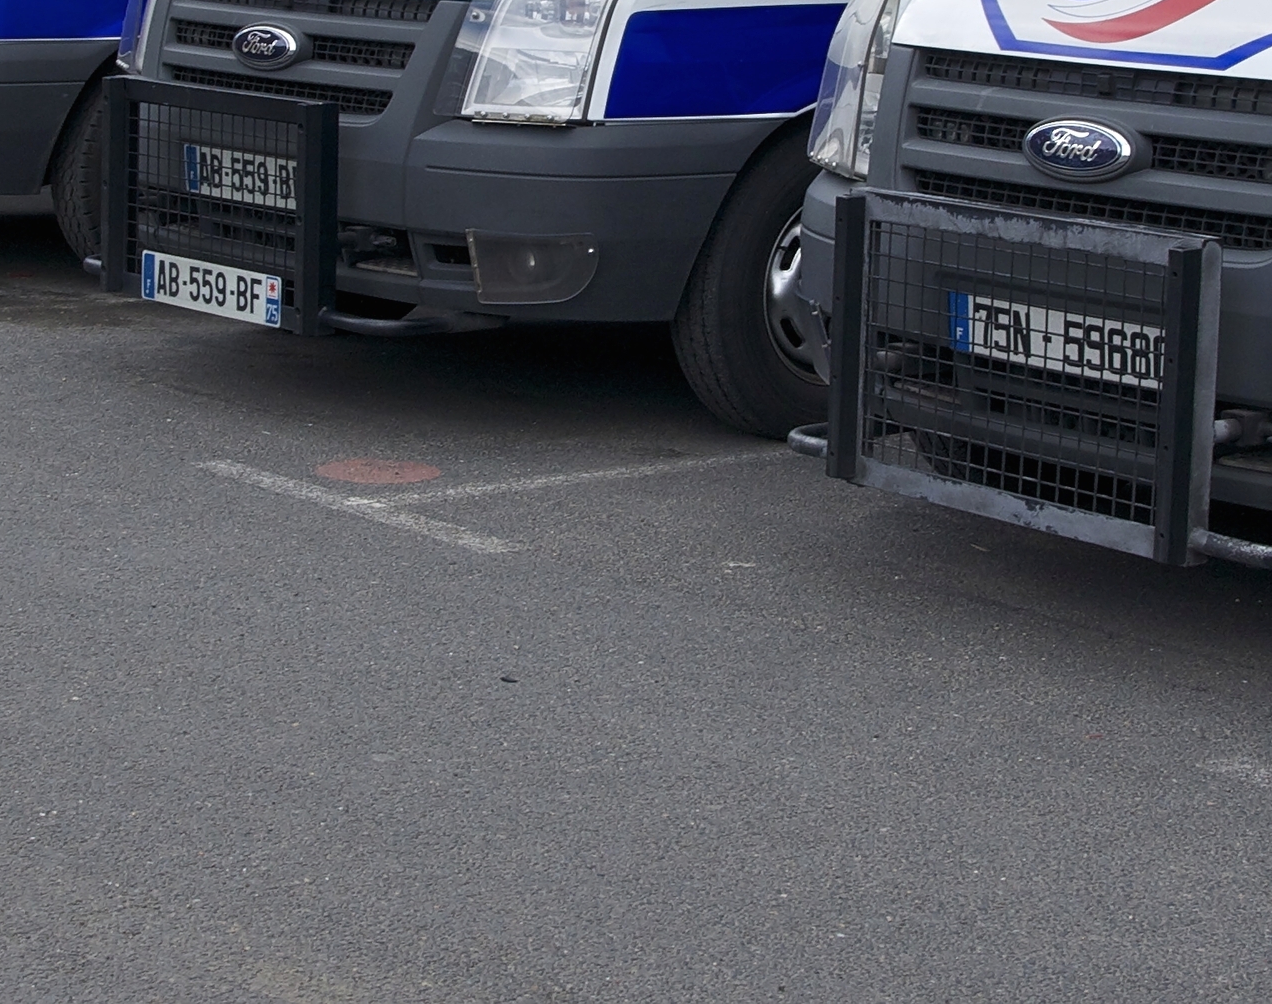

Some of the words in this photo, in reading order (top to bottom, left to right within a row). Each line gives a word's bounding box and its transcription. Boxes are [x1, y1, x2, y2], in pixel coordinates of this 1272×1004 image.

[242, 31, 278, 56] Ford
[1042, 127, 1102, 162] Ford
[157, 259, 262, 314] AB-559-BF
[266, 304, 278, 322] 75
